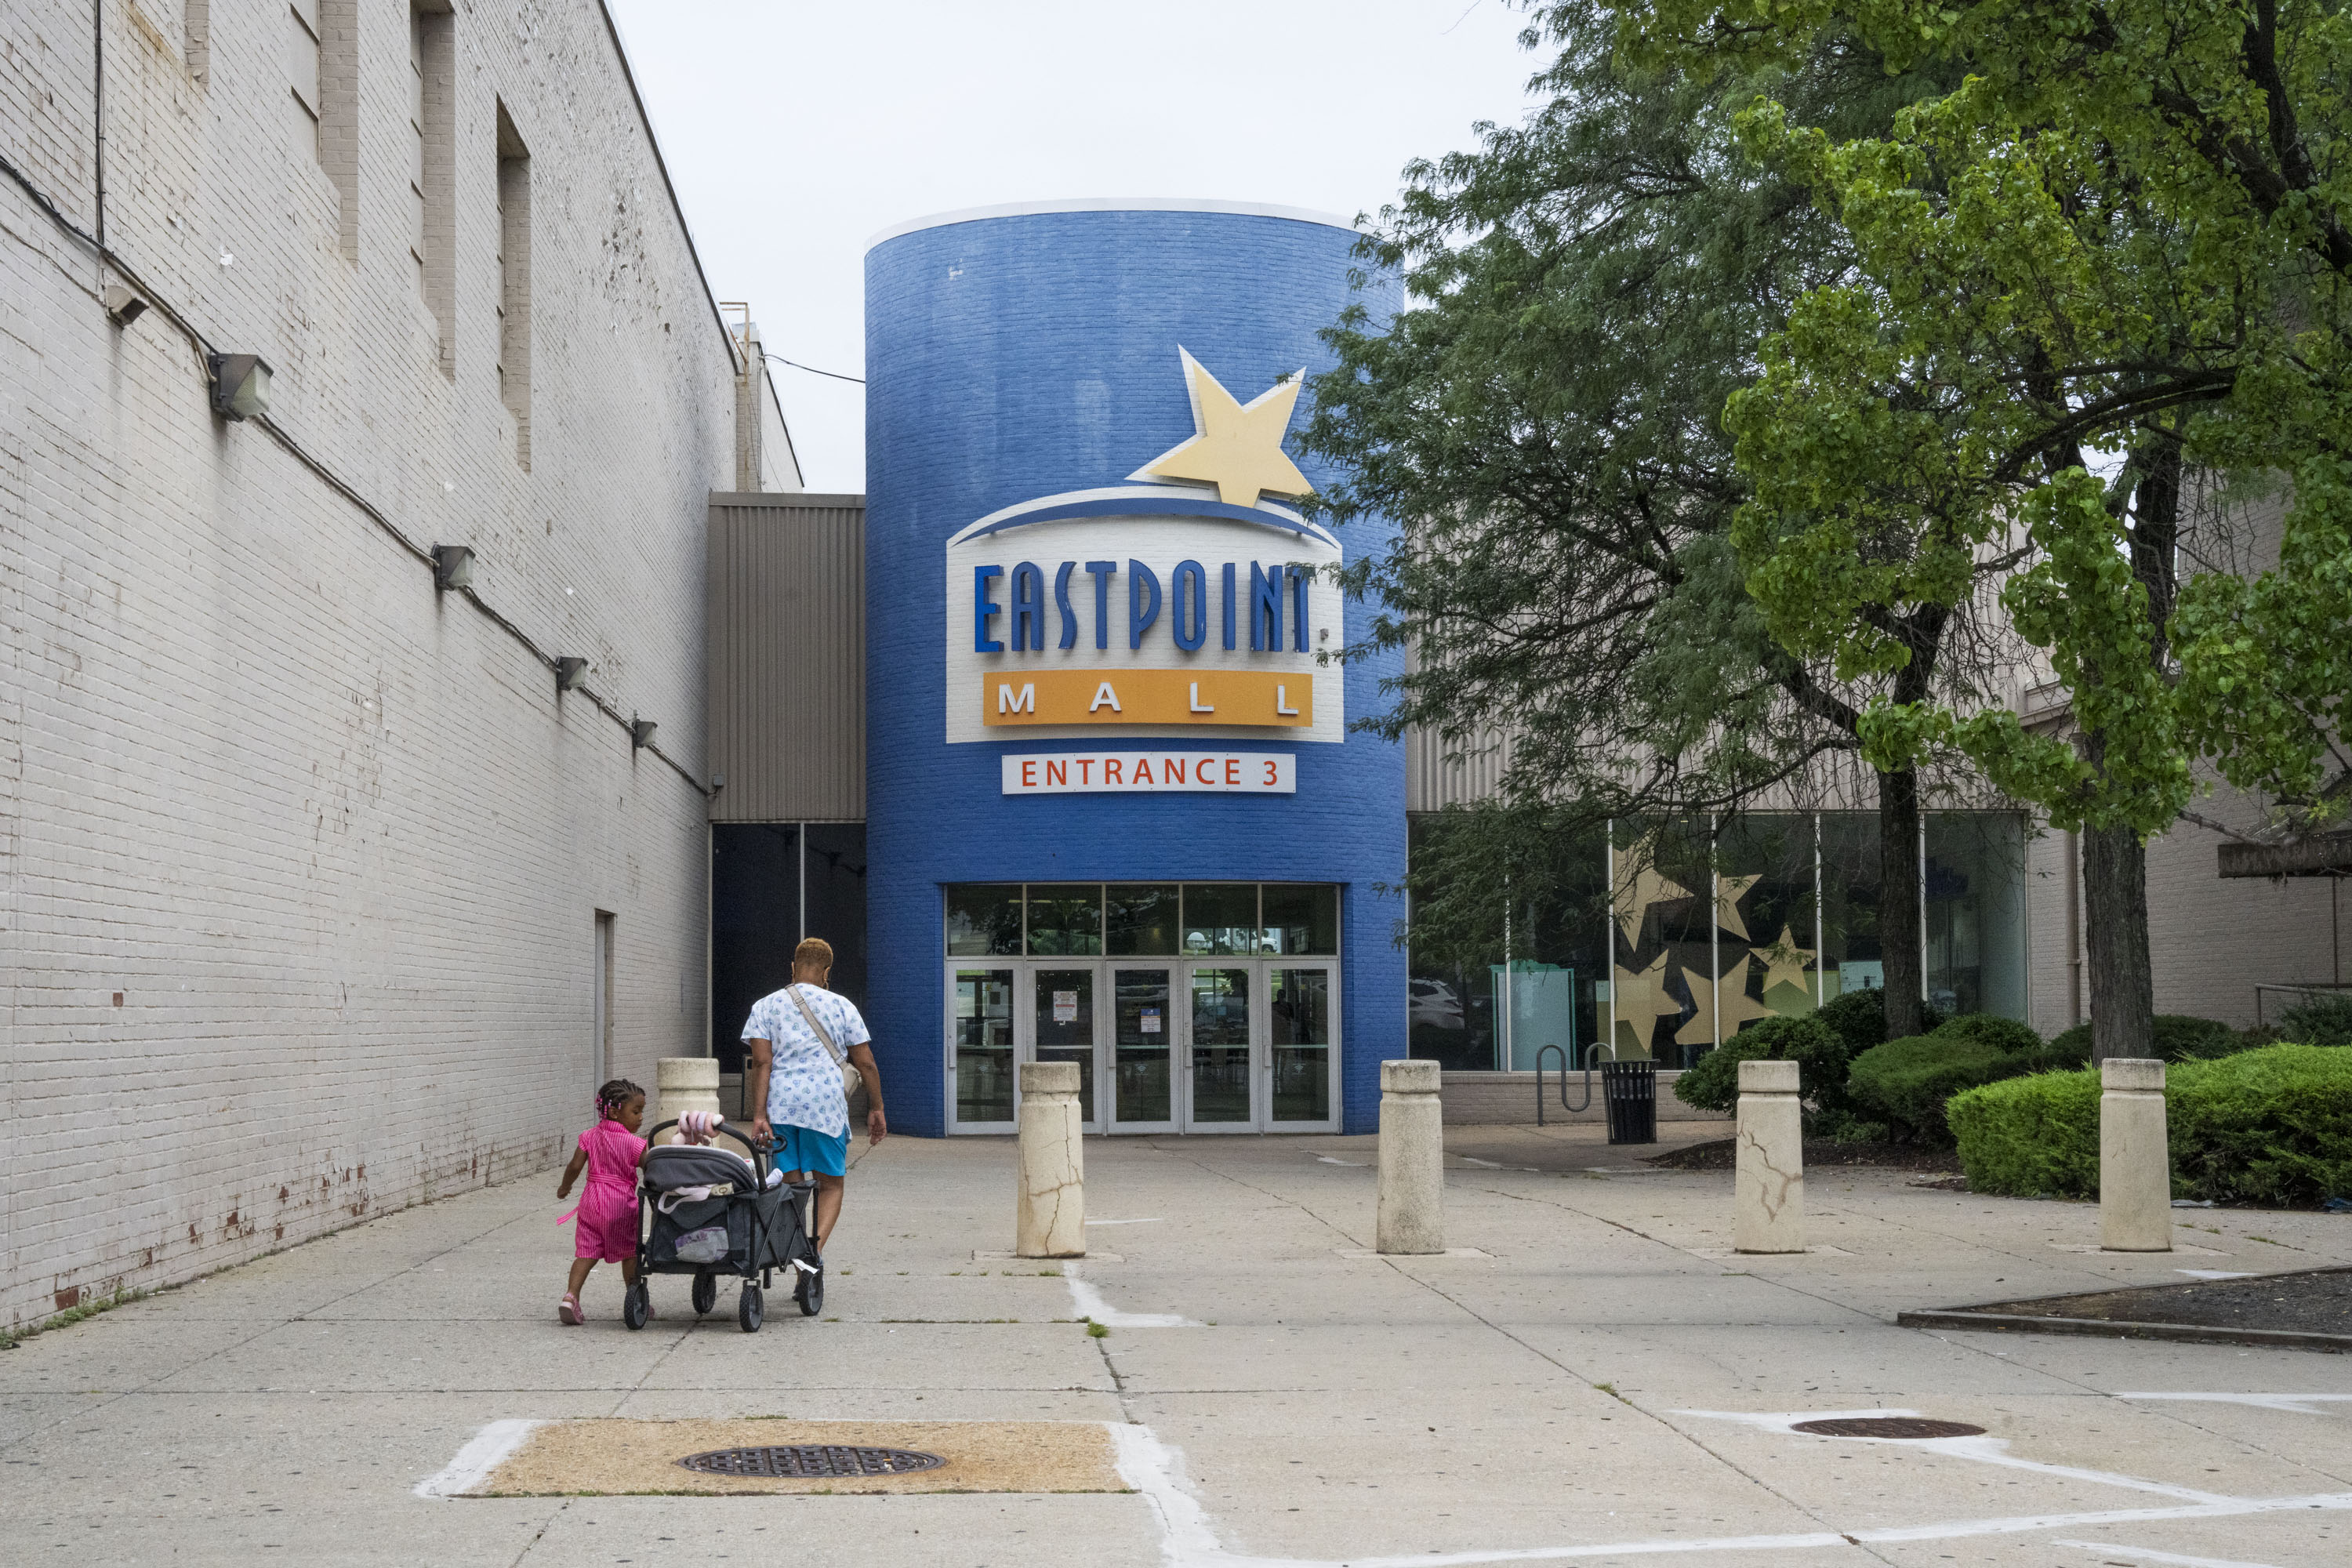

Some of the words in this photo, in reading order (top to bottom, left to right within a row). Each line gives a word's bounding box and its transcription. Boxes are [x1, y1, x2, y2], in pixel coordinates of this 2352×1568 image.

[975, 559, 1316, 652] EASTPOINT
[999, 682, 1299, 714] MALL
[1022, 759, 1240, 786] ENTRANCE
[1263, 760, 1278, 786] 3
